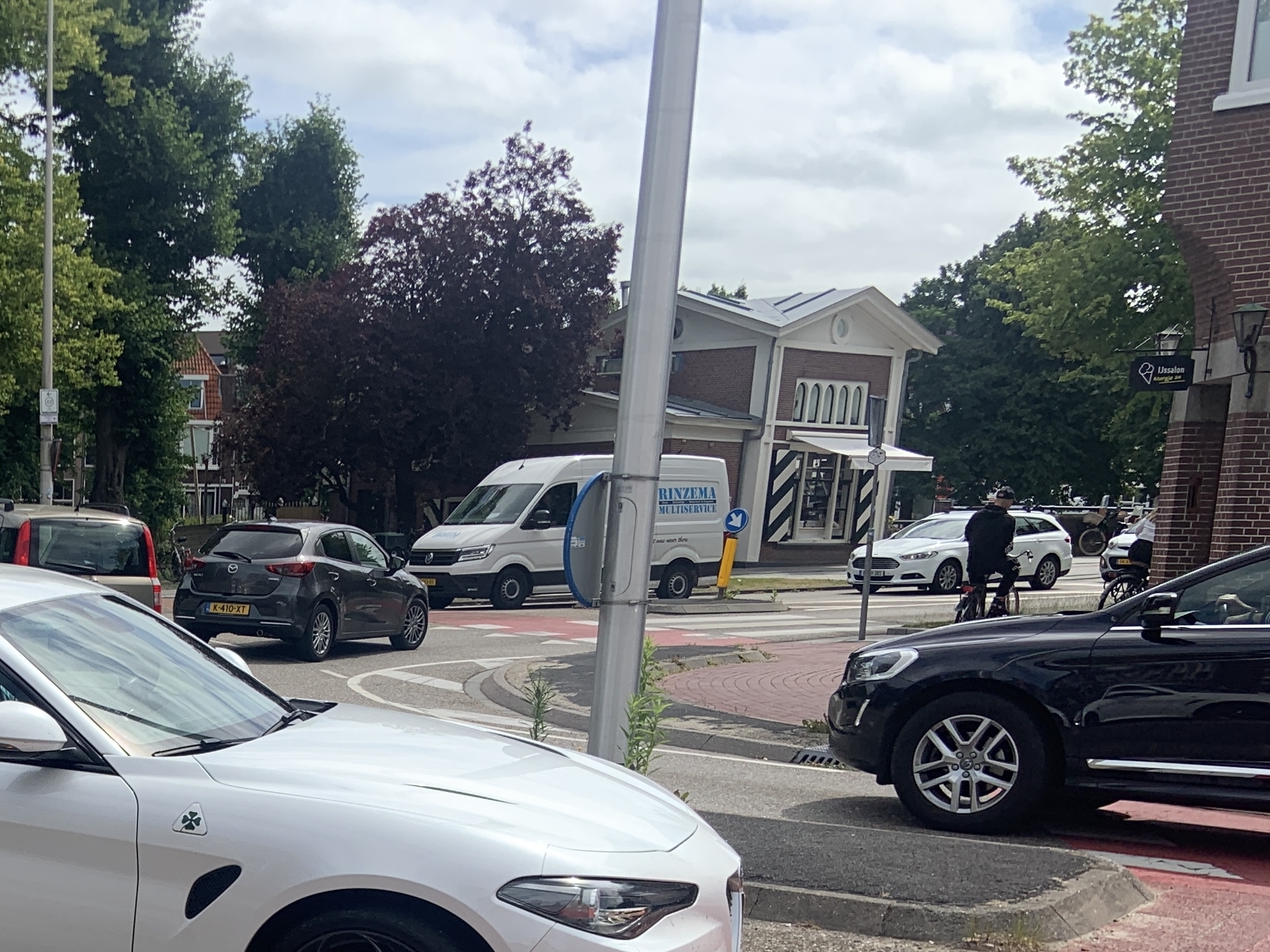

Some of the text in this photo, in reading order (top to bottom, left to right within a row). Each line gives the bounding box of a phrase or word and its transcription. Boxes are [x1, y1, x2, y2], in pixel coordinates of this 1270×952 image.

[658, 487, 716, 500] RINZEMA
[658, 505, 717, 514] MULTISERVICE
[212, 604, 246, 613] K-410-XT
